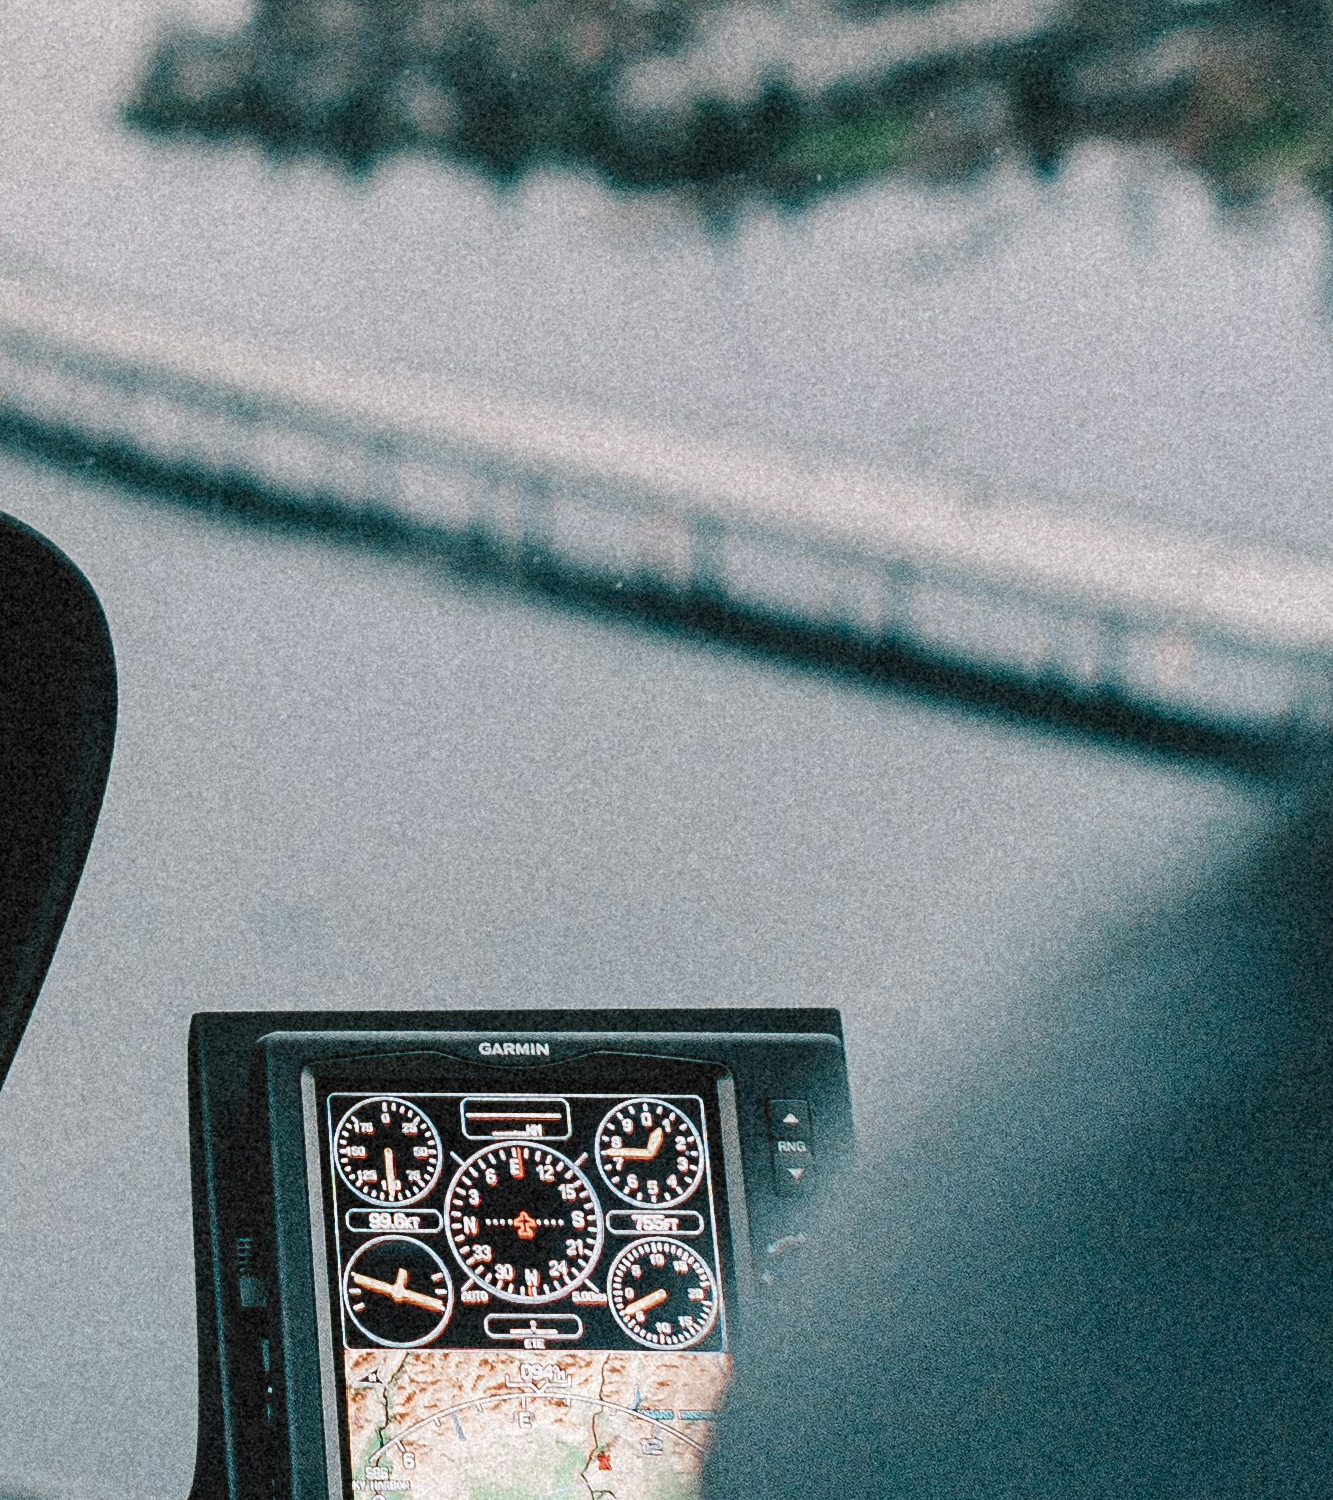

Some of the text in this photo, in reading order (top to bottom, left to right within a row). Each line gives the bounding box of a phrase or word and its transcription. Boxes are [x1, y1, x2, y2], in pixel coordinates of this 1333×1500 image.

[479, 1041, 550, 1057] GARMIN
[622, 1118, 634, 1134] 9
[640, 1112, 652, 1127] 0
[662, 1117, 671, 1133] 1
[611, 1135, 622, 1149] 8
[675, 1136, 687, 1151] 2
[777, 1139, 806, 1154] RNG
[510, 1158, 521, 1178] E
[613, 1157, 623, 1171] 7
[677, 1156, 688, 1172] 3
[486, 1169, 498, 1187] 6
[536, 1164, 555, 1182] 12
[666, 1174, 678, 1190] 4
[469, 1189, 481, 1207] 3
[558, 1183, 577, 1200] 15
[463, 1216, 479, 1236] N
[571, 1210, 585, 1228] S
[472, 1244, 493, 1263] 33
[565, 1239, 583, 1257] 21
[494, 1264, 515, 1282] 30
[548, 1260, 568, 1278] 24
